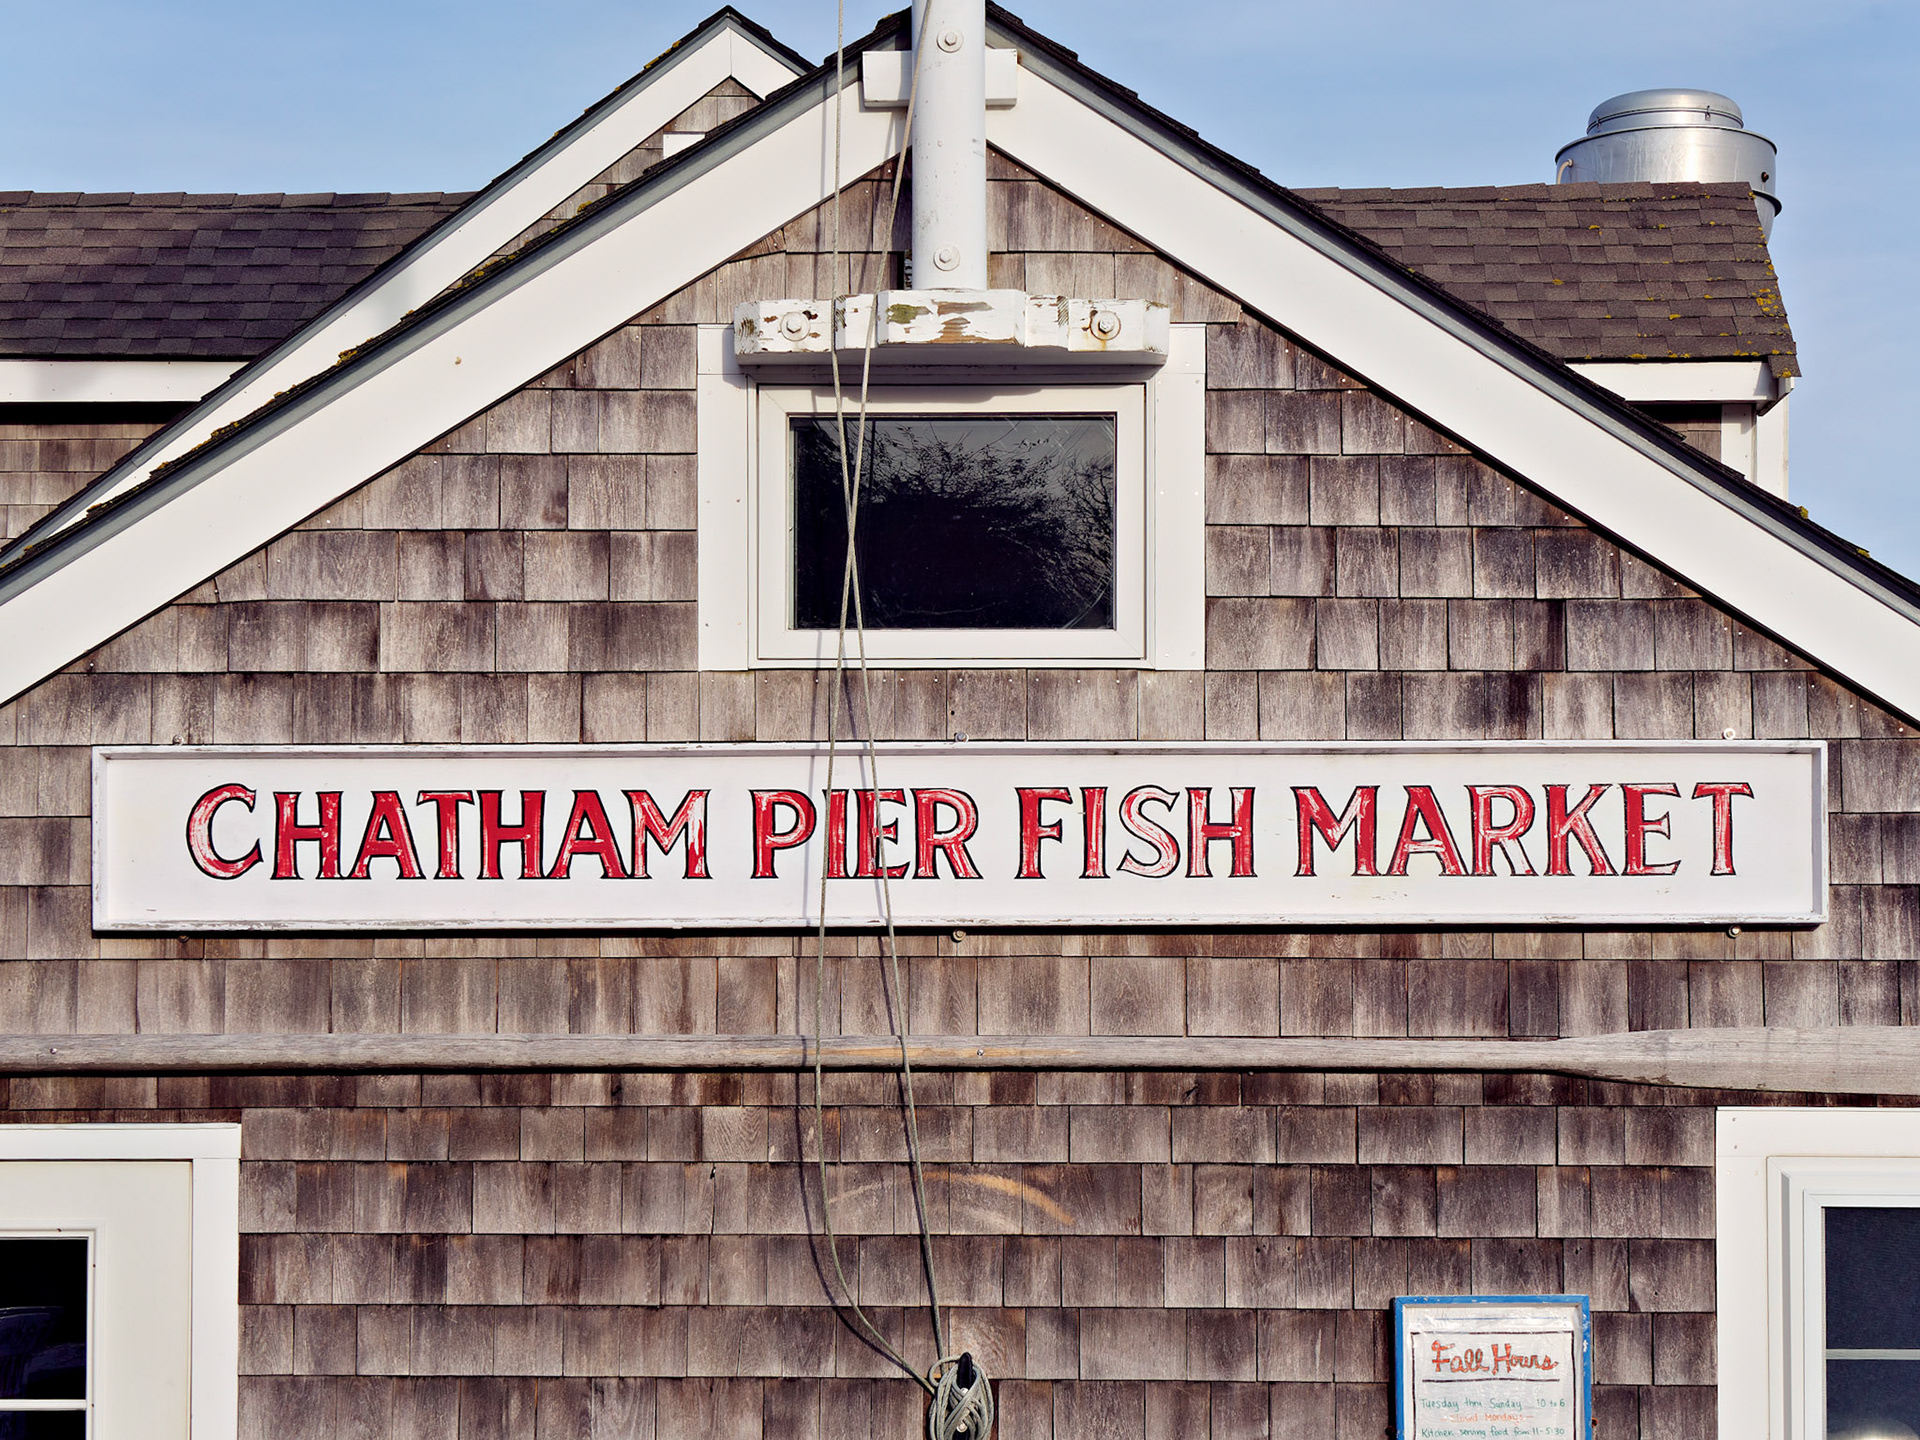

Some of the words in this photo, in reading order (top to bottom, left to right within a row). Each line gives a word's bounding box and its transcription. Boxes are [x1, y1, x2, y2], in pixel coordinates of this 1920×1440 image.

[186, 782, 708, 881] CHATHAM
[750, 787, 984, 880] PIER
[1014, 784, 1255, 879] FISH
[1292, 782, 1755, 878] MARKET
[1431, 1340, 1490, 1373] Fall
[1491, 1343, 1559, 1375] Hours
[1420, 1397, 1459, 1413] Tuesday
[1489, 1397, 1522, 1412] Sunday
[1549, 1399, 1557, 1407] to
[1559, 1398, 1566, 1407] 6
[1459, 1428, 1486, 1439] serving
[1490, 1425, 1509, 1436] food
